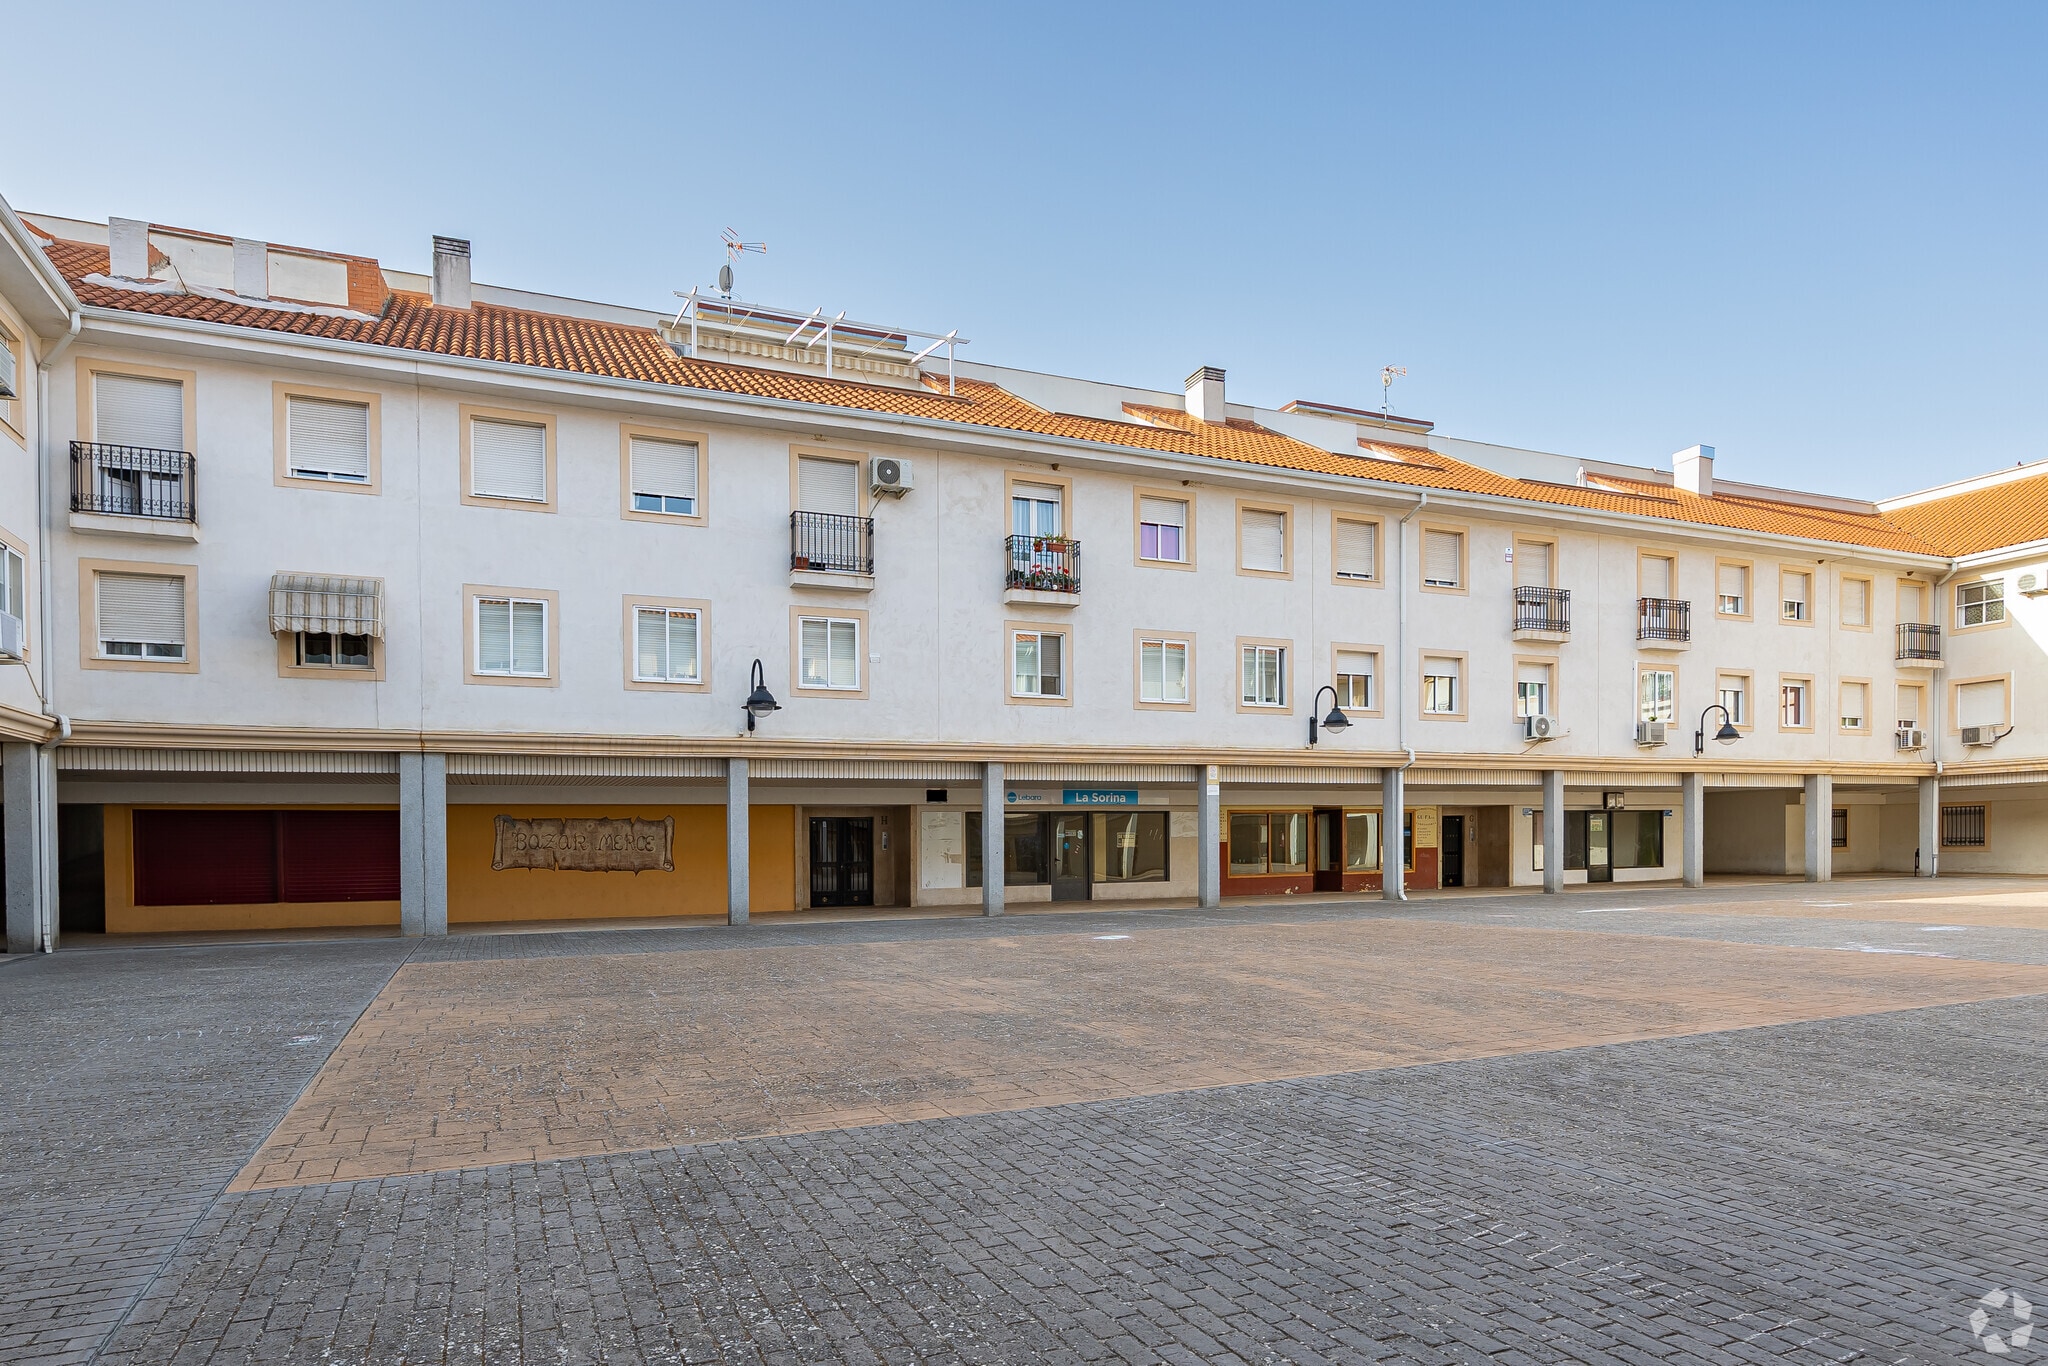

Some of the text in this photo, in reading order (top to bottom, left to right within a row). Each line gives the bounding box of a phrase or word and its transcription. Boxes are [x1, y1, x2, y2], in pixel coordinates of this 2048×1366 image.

[1075, 792, 1126, 803] La Sorina
[881, 815, 888, 825] H
[595, 833, 655, 852] MERCE
